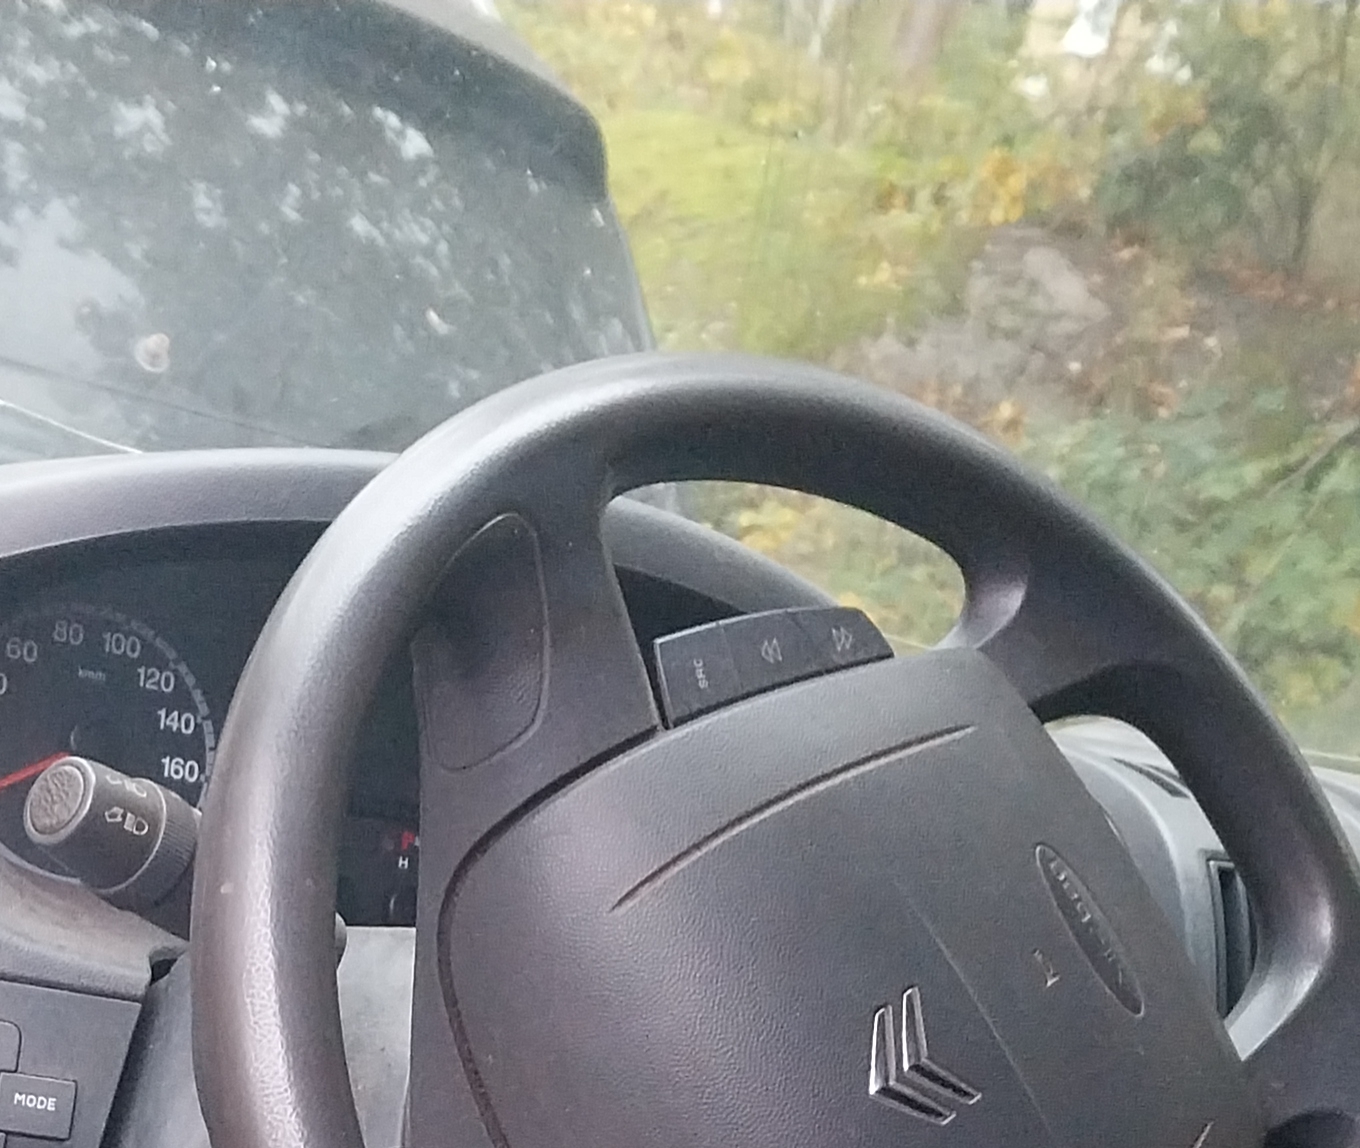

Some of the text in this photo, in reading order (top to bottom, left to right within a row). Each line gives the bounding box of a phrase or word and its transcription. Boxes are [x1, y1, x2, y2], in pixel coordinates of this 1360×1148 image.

[52, 619, 84, 645] 80
[6, 637, 38, 663] 60
[102, 632, 141, 659] 100
[137, 666, 175, 693] 120
[157, 707, 195, 735] 140
[161, 756, 199, 783] 160
[398, 856, 409, 869] H
[14, 1093, 56, 1112] MODE
